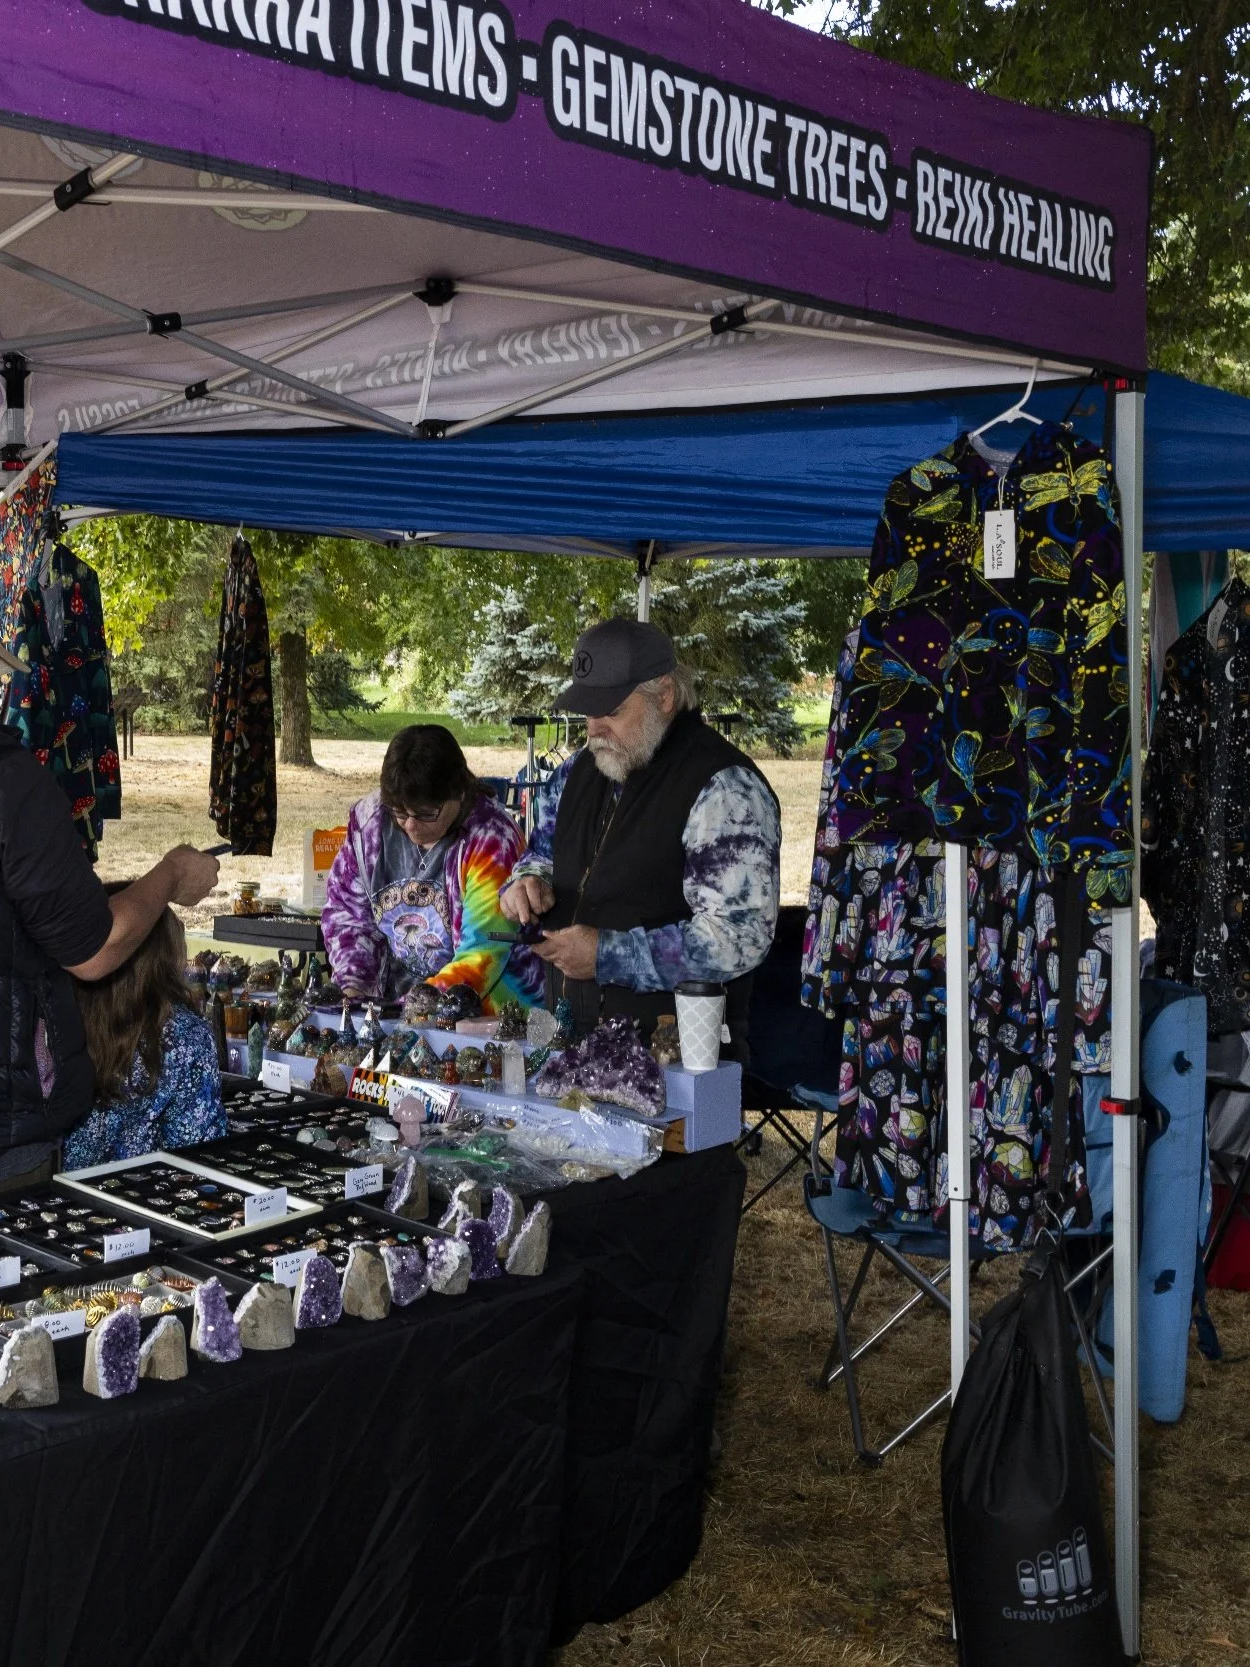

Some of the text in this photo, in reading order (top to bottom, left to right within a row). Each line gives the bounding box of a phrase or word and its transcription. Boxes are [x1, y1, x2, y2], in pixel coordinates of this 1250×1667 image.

[350, 0, 508, 107] ITEMS
[551, 34, 777, 188] GEMSTONE
[783, 115, 888, 221] TREES
[914, 159, 994, 249] REIKI
[996, 188, 1115, 282] HEALING
[352, 1078, 385, 1098] ROCKS
